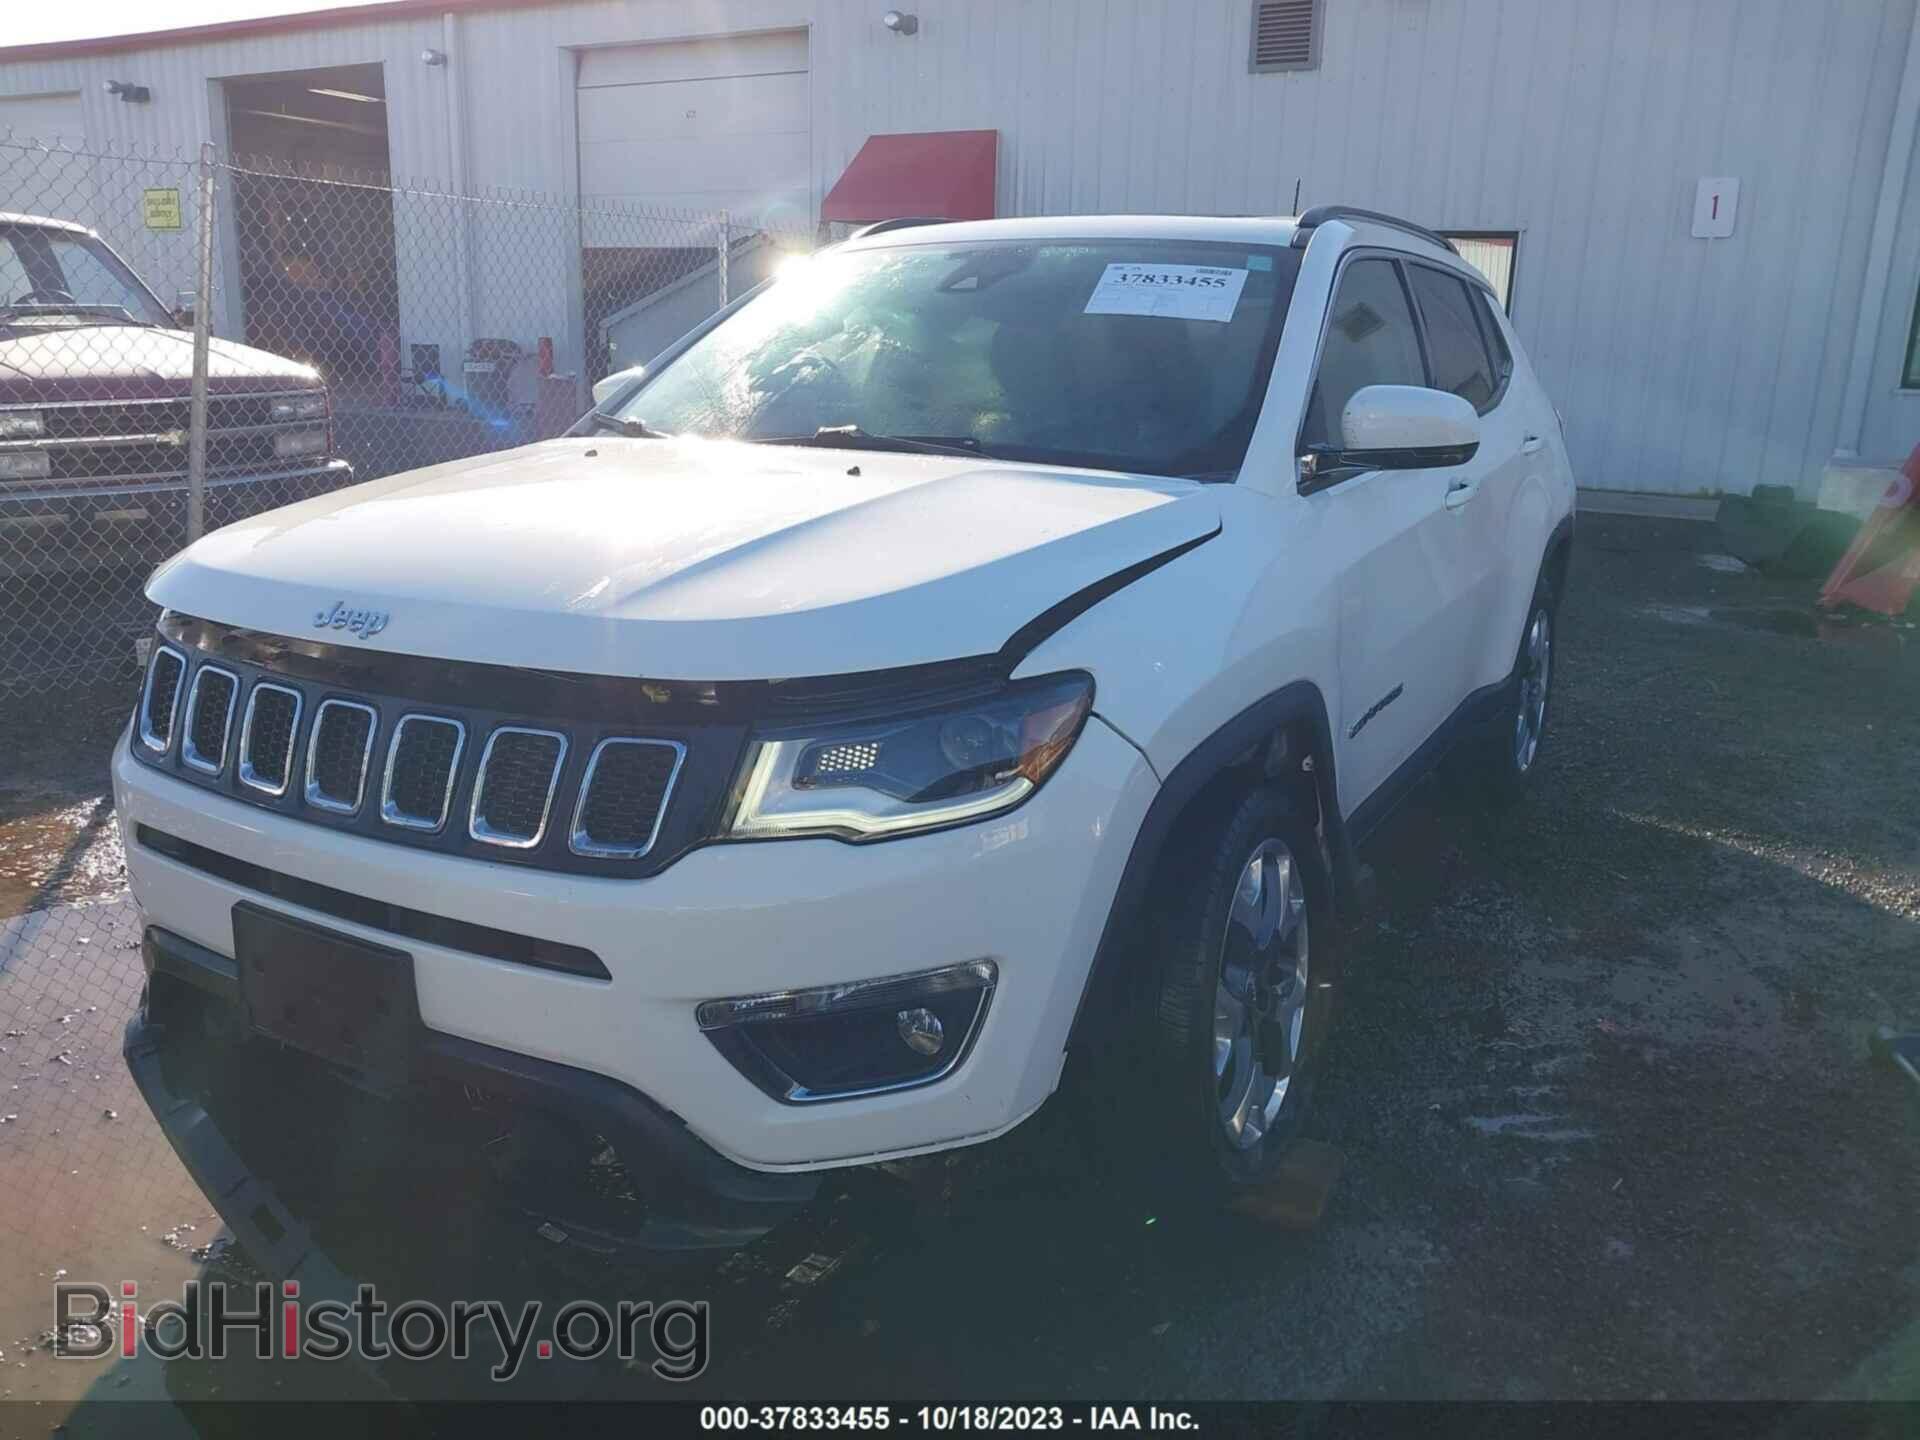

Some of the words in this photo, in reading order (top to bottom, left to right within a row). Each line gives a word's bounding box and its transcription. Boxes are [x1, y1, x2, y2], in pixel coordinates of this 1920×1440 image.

[1711, 194, 1720, 221] 1
[1113, 273, 1227, 289] 37833455
[313, 601, 390, 640] Jeep
